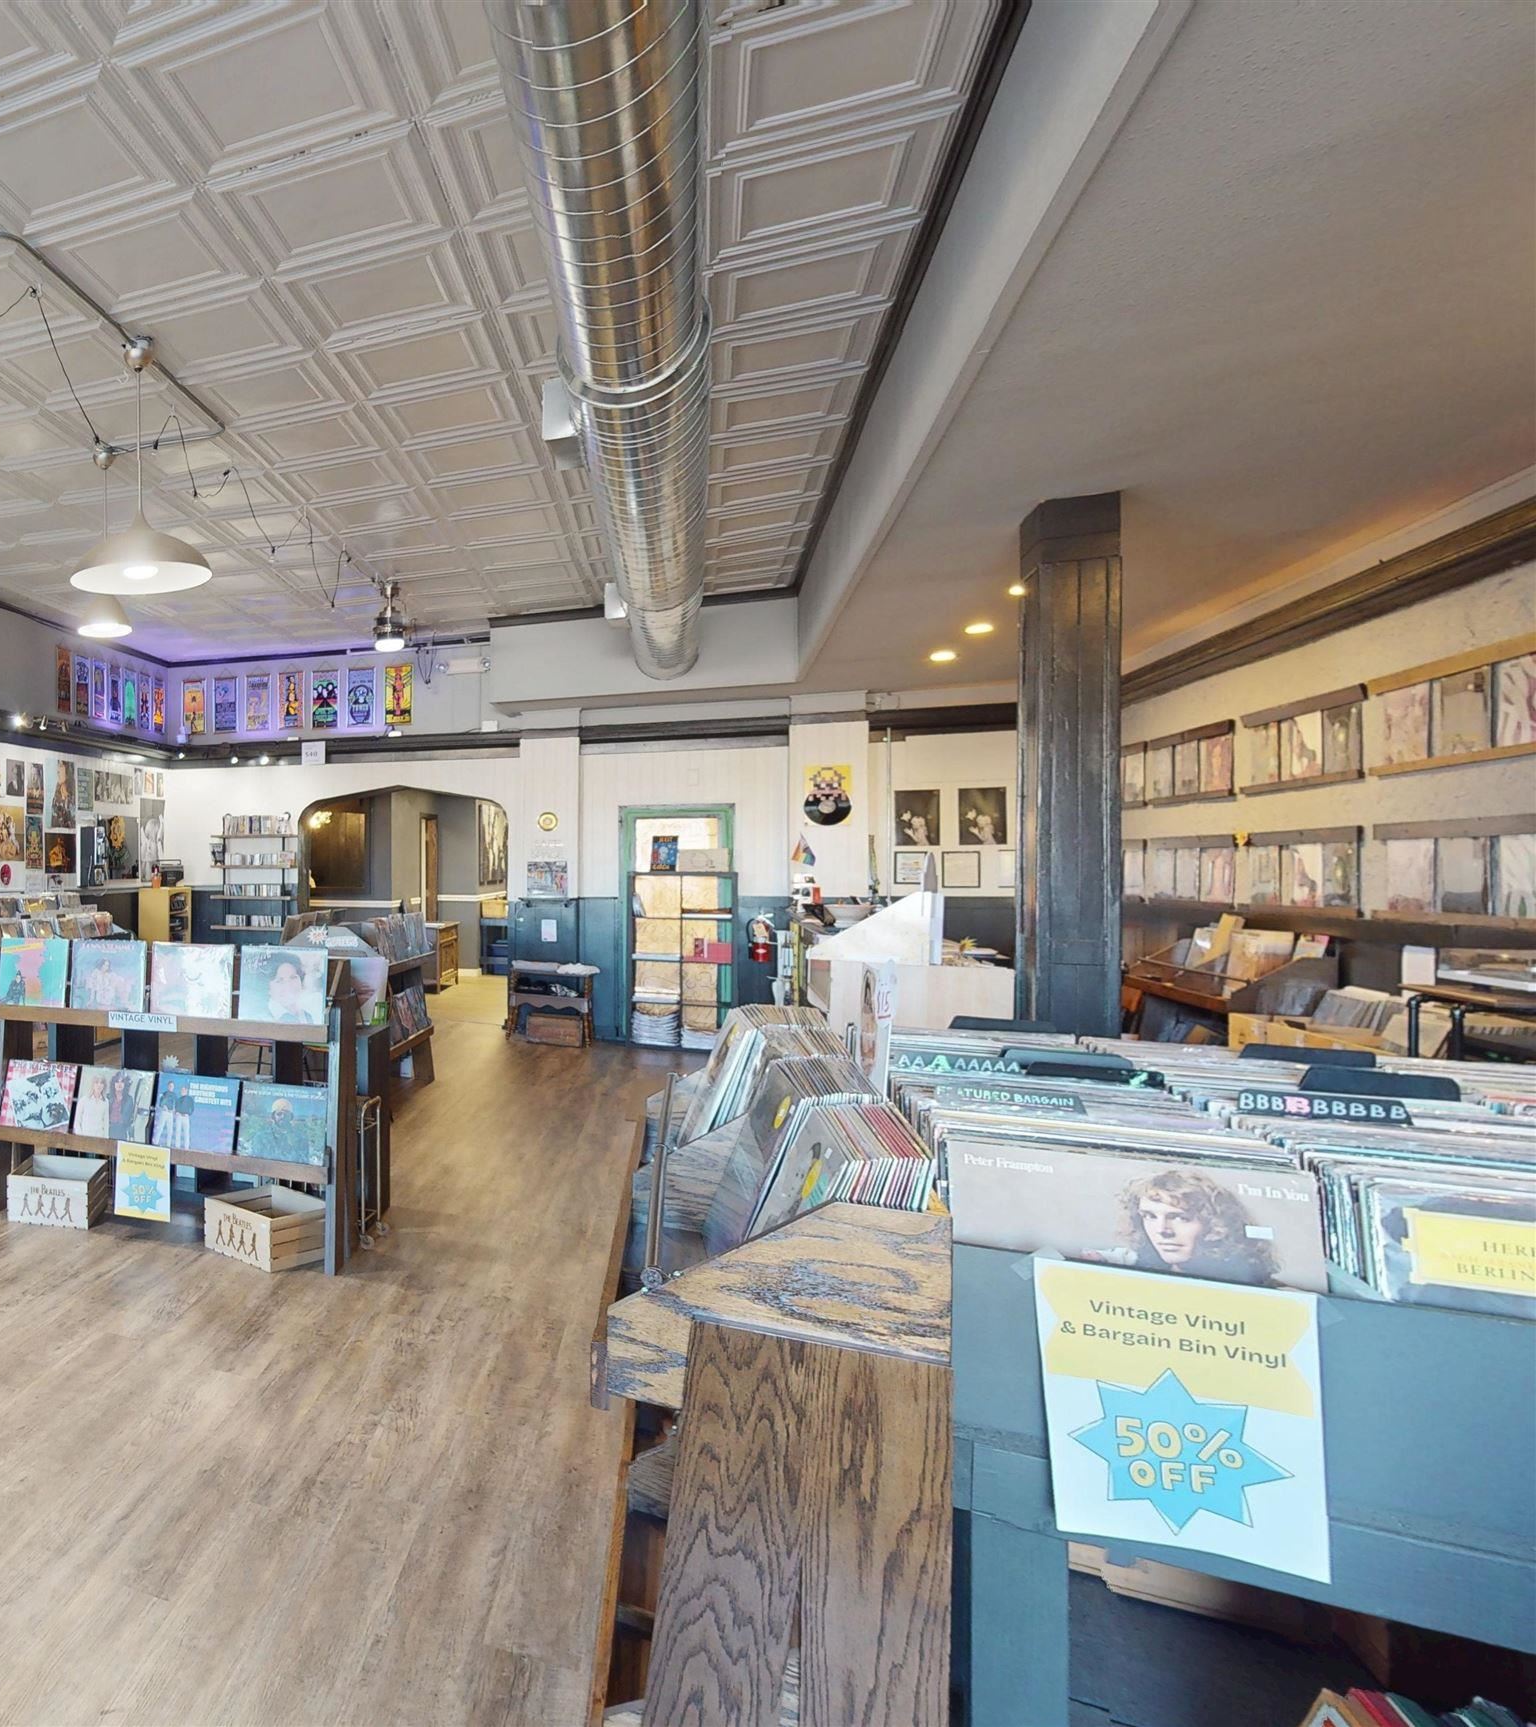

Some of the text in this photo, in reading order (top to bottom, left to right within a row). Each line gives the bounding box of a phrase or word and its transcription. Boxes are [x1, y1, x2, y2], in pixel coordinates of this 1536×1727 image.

[110, 1012, 174, 1025] VINTAGE VINYL
[936, 1085, 1074, 1107] FATURED BARGAIN
[964, 1153, 1053, 1175] Peter Frampton
[131, 1183, 156, 1195] 50%
[134, 1195, 152, 1204] OFF
[1237, 1183, 1310, 1202] I'm In You
[1482, 1240, 1536, 1258] HER
[1089, 1299, 1246, 1335] Vintage Vinyl
[1060, 1320, 1287, 1369] & Bargain Bin Vinyl
[1115, 1415, 1245, 1470] 50%
[1128, 1458, 1217, 1495] OFF
